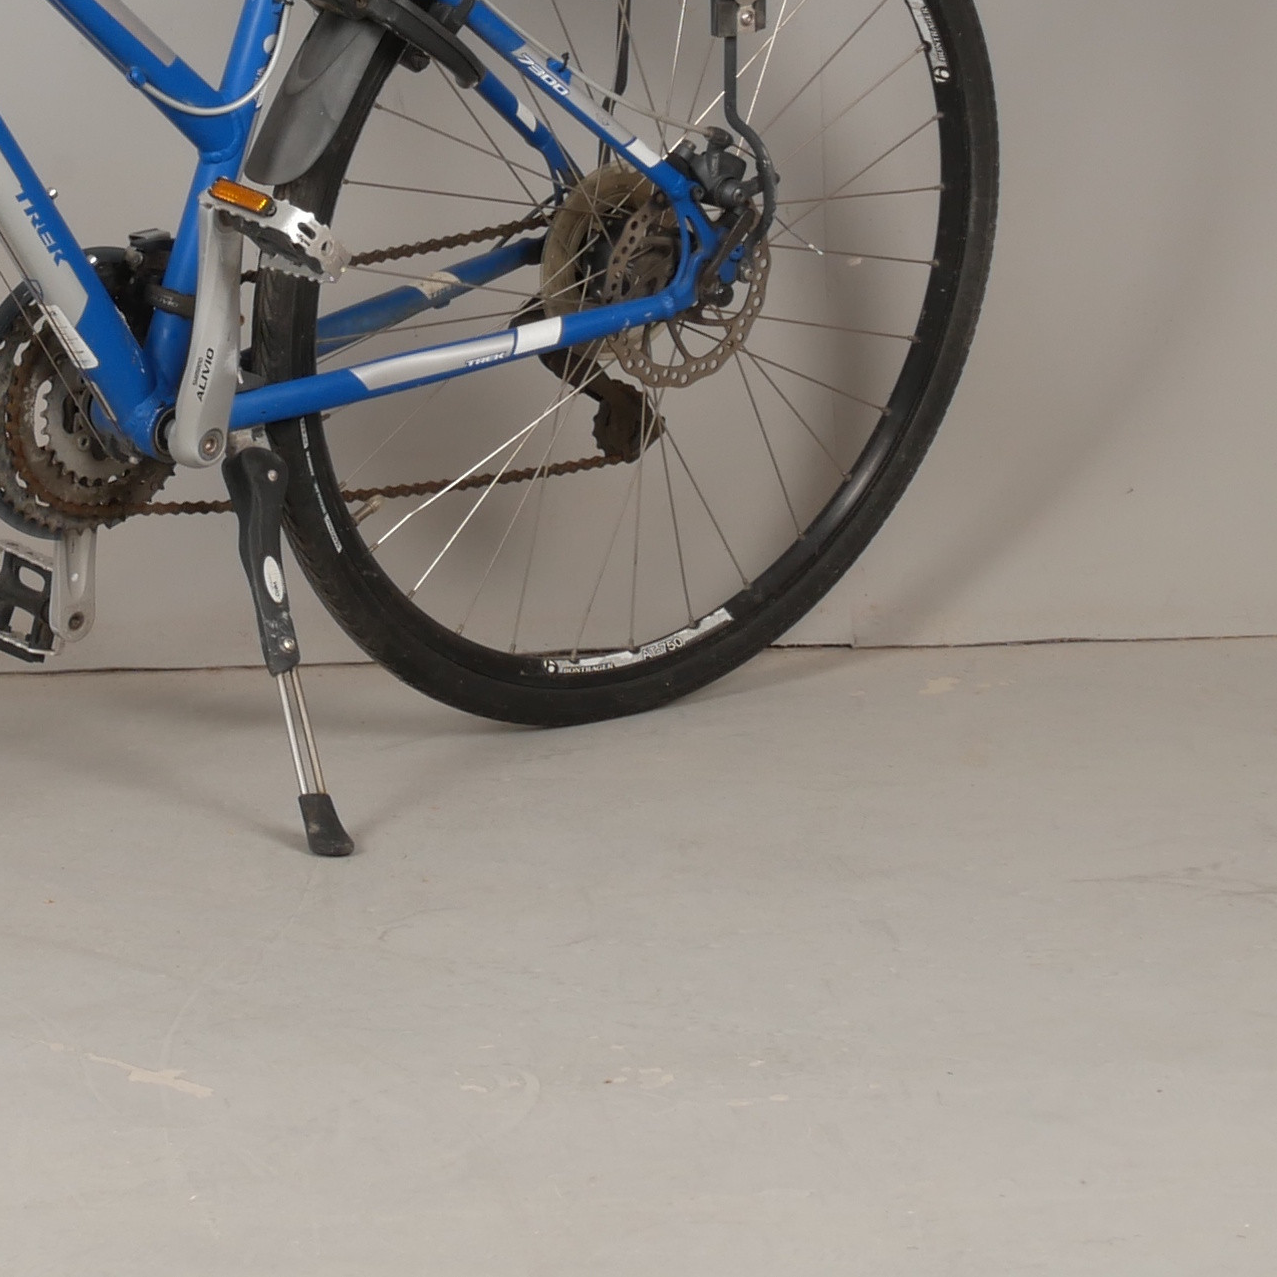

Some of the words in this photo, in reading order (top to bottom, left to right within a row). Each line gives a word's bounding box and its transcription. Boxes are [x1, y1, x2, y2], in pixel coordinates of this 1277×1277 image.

[517, 53, 570, 97] 7300
[15, 186, 67, 266] TREK
[196, 347, 215, 402] ALIVIO
[466, 351, 506, 367] TREK
